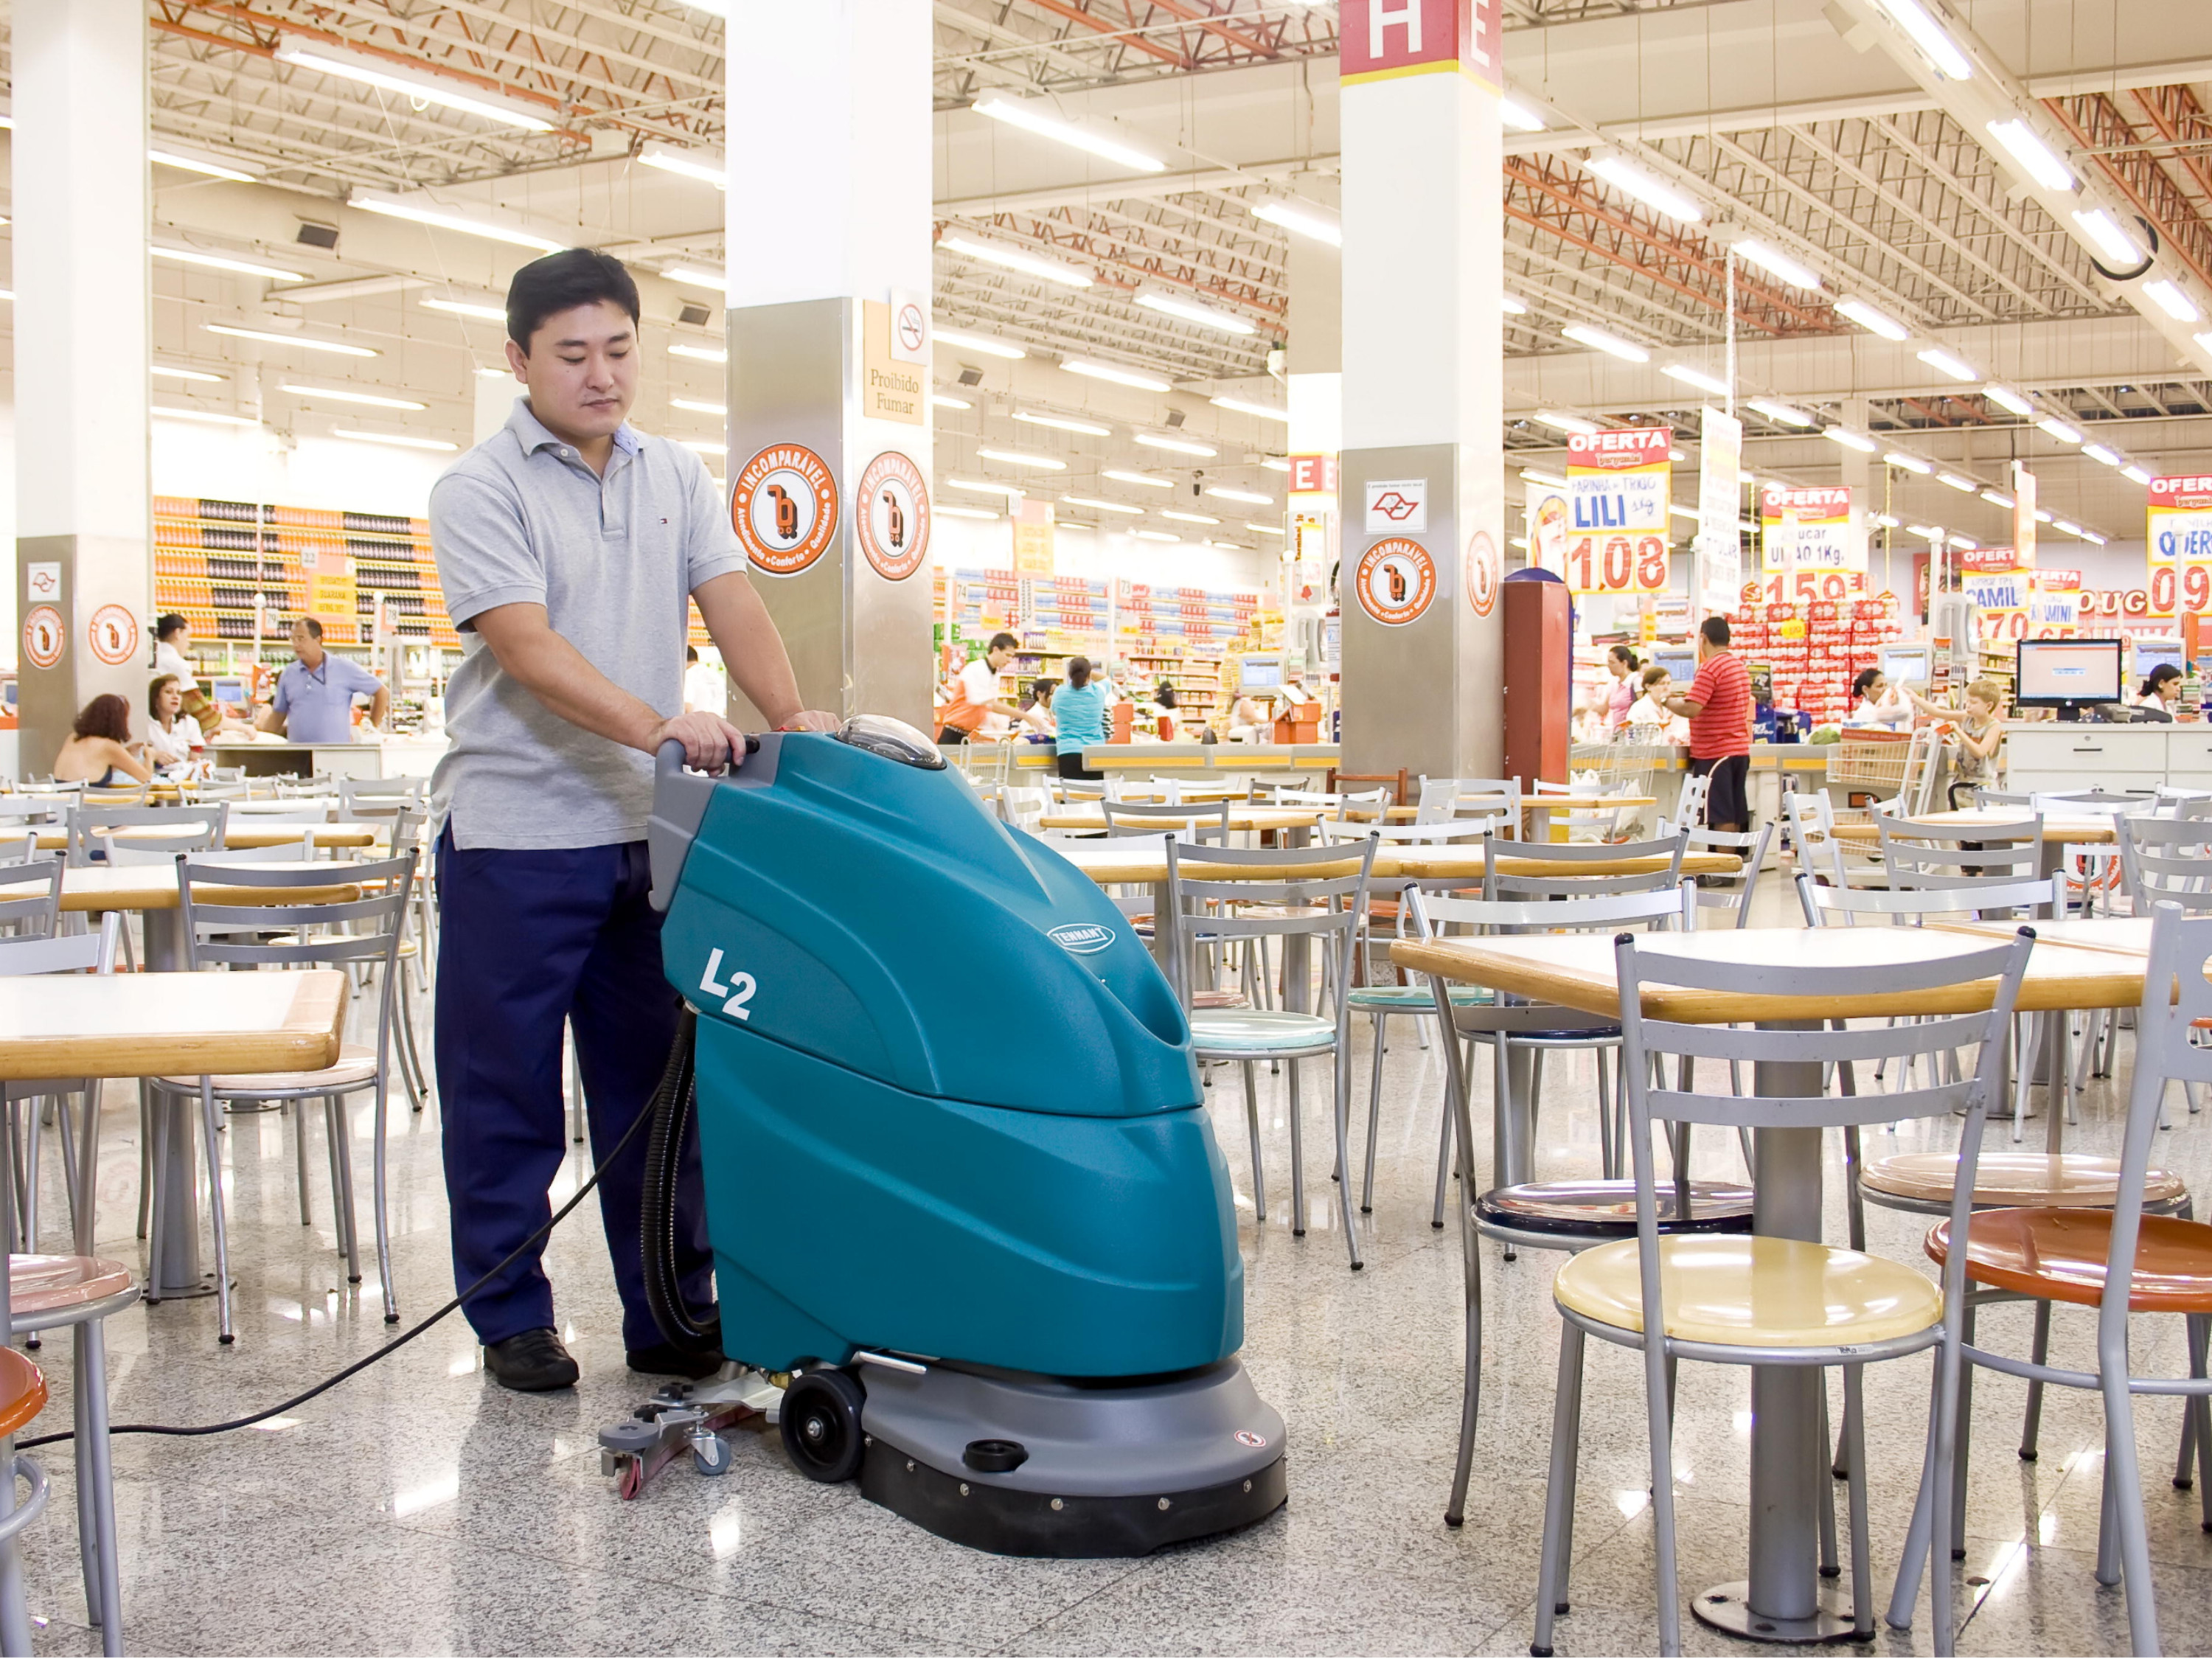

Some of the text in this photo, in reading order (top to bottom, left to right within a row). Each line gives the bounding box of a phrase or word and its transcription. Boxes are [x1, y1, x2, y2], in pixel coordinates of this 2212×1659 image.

[1369, 0, 1422, 59] H
[1470, 0, 1489, 68] E
[871, 368, 919, 394] Proibido
[877, 392, 914, 415] Fumar
[1569, 431, 1666, 452] OFERTA
[740, 450, 827, 492] INCOMPARÁVEL
[864, 458, 924, 504] INCOMPARÁVEL
[1296, 461, 1314, 489] E
[1326, 461, 1335, 489] E
[1765, 490, 1848, 506] OFERTA
[2152, 478, 2212, 493] OFER
[1575, 494, 1626, 527] LILI
[737, 502, 832, 567] Atendimento Conforto Qualidade
[1364, 541, 1428, 570] INCOMPARÁVEL
[1572, 536, 1665, 591] 1,08
[1964, 550, 2014, 562] OFERT
[1121, 580, 1130, 594] 73
[2030, 571, 2079, 581] FERTA
[957, 584, 967, 598] 74
[267, 613, 276, 626] 79
[387, 609, 397, 621] 78
[1052, 927, 1108, 946] TENNANT
[699, 947, 757, 1020] L2
